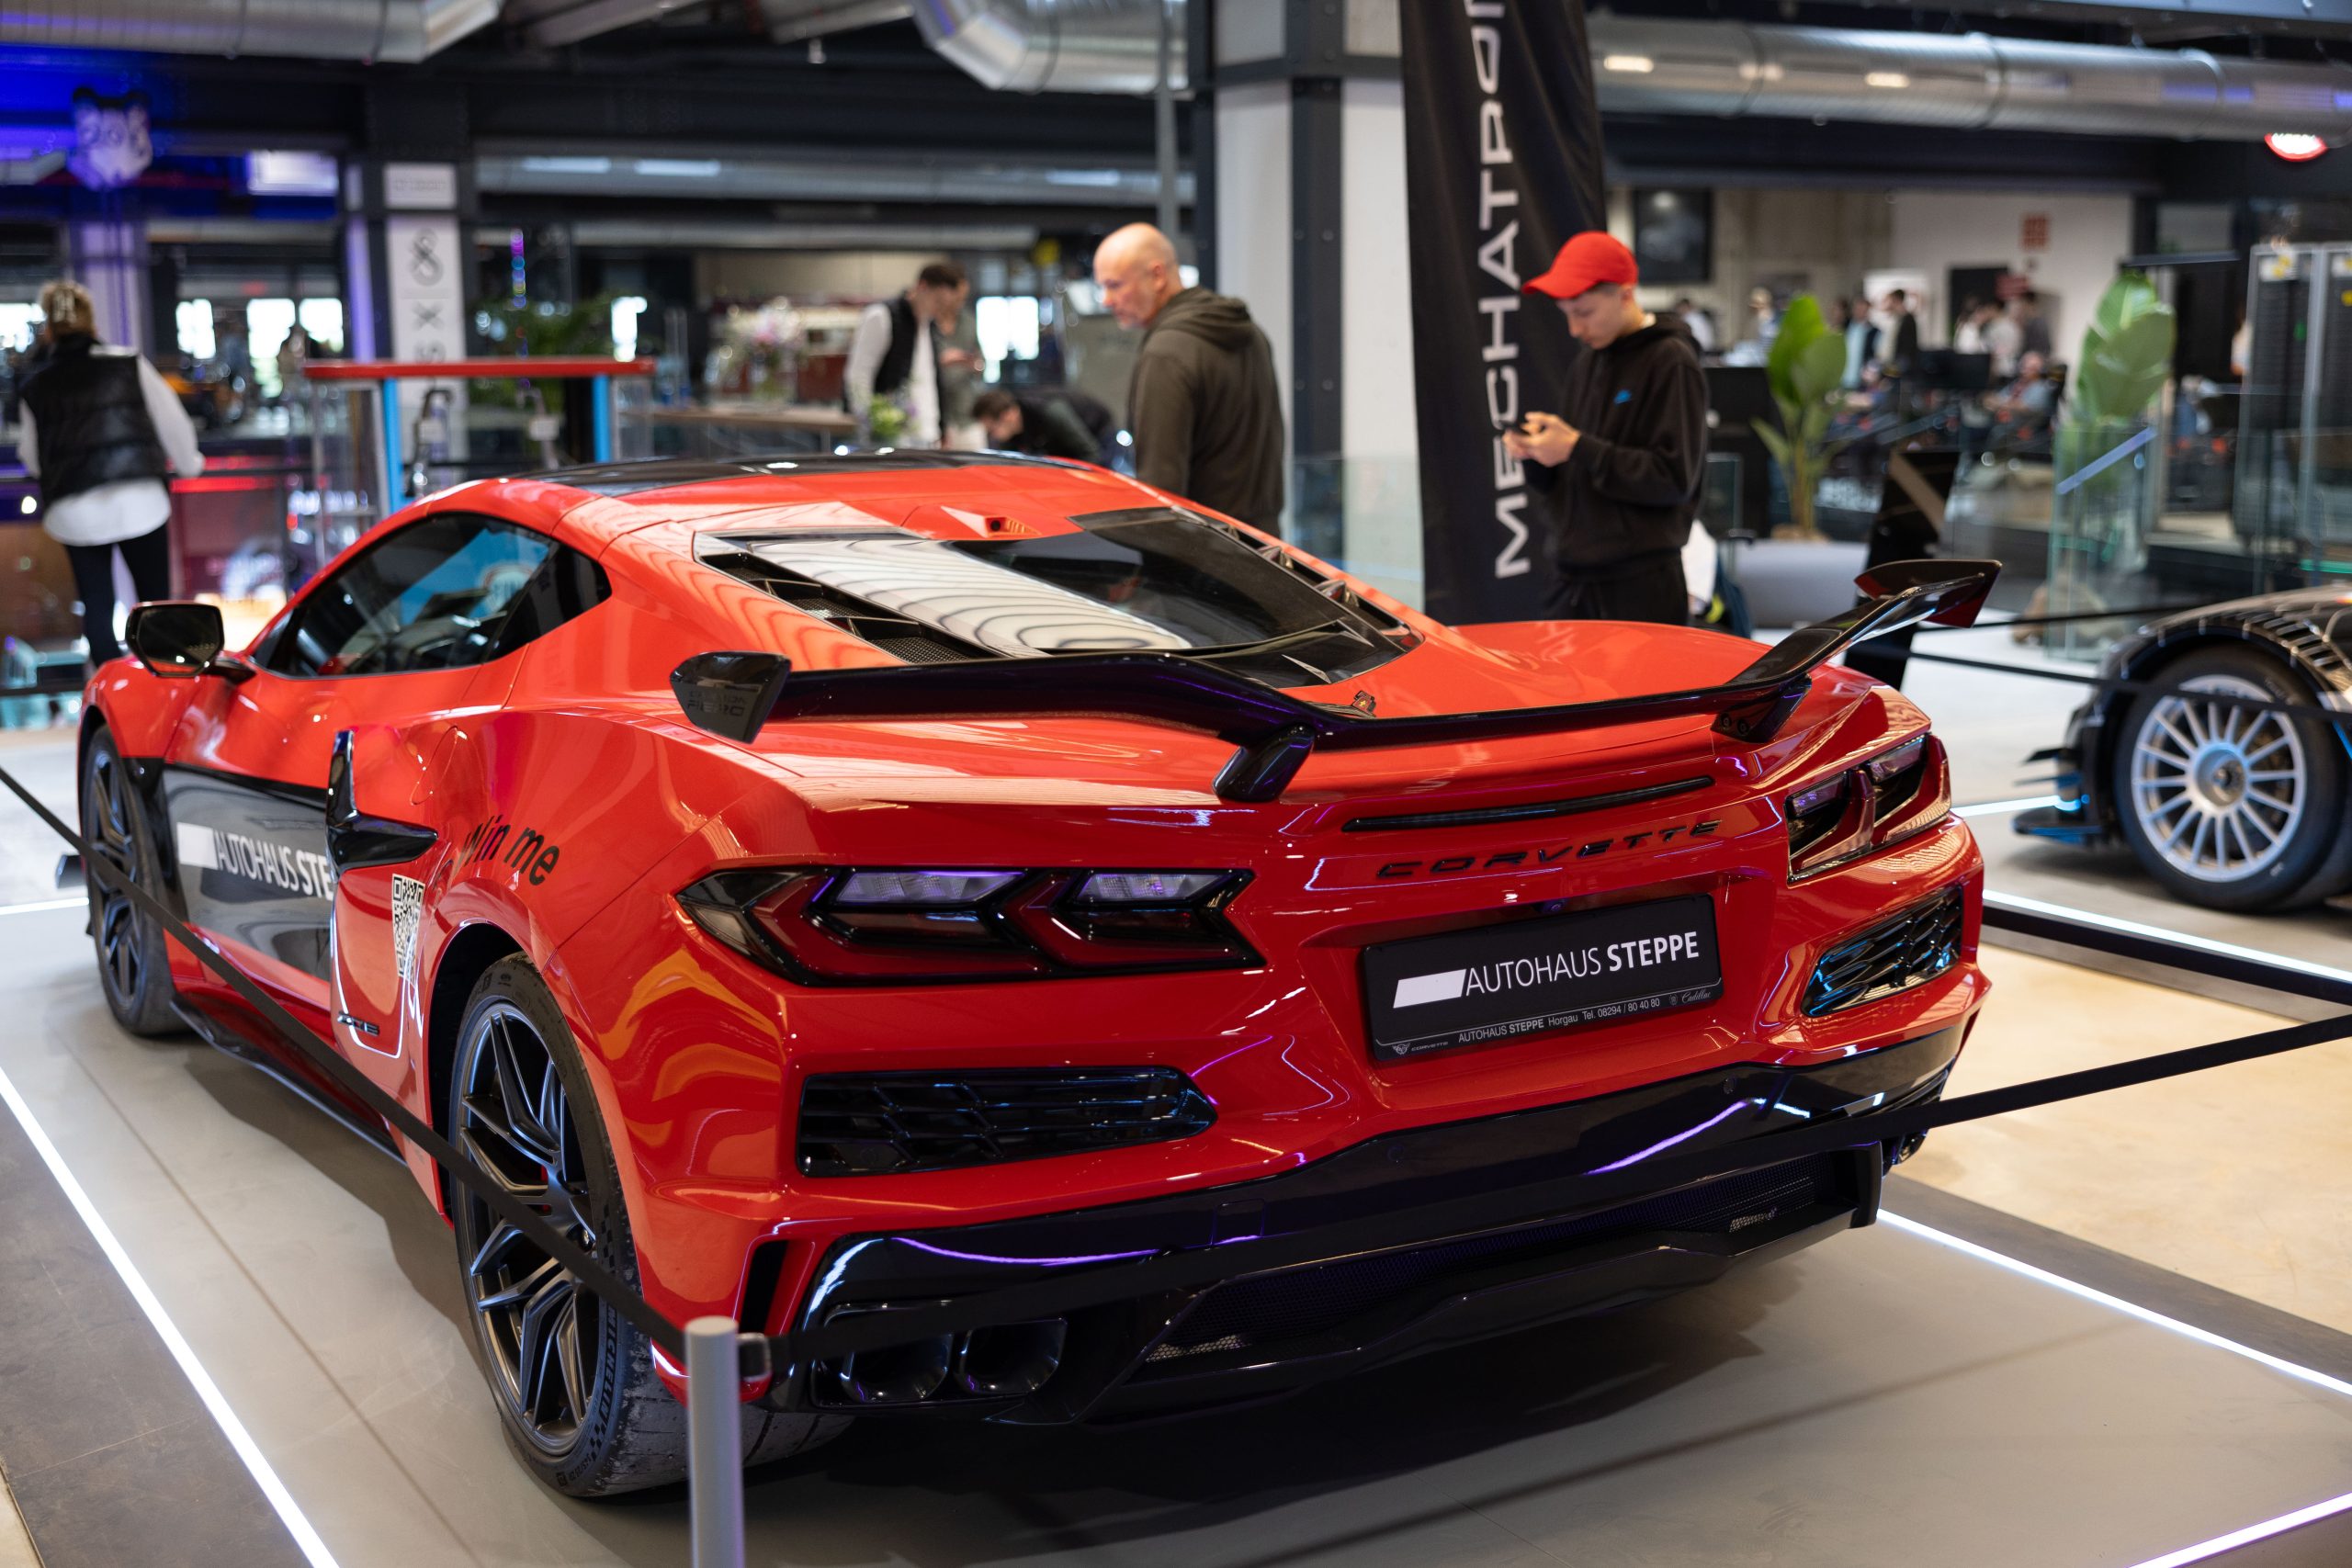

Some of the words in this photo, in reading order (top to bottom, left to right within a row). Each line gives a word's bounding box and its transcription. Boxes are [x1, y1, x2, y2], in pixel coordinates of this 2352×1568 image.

[213, 829, 300, 893] AUTOHAUS
[503, 827, 560, 886] me
[1376, 818, 1723, 879] CORVETTE
[1465, 947, 1602, 998] AUTOHAUS
[1606, 931, 1700, 973] STEPPE
[1458, 1025, 1508, 1043] AUTOHAUS
[1509, 1018, 1545, 1034] STEPPE
[1548, 1013, 1578, 1027] Horgau
[1581, 1010, 1596, 1021] Tel.
[1598, 1005, 1623, 1019] 08294
[1627, 1001, 1638, 1012] 80
[1639, 999, 1650, 1010] 40
[1681, 987, 1712, 1004] Cadillac
[1411, 1041, 1449, 1052] CORVETTE
[600, 1305, 616, 1418] MICHELIN
